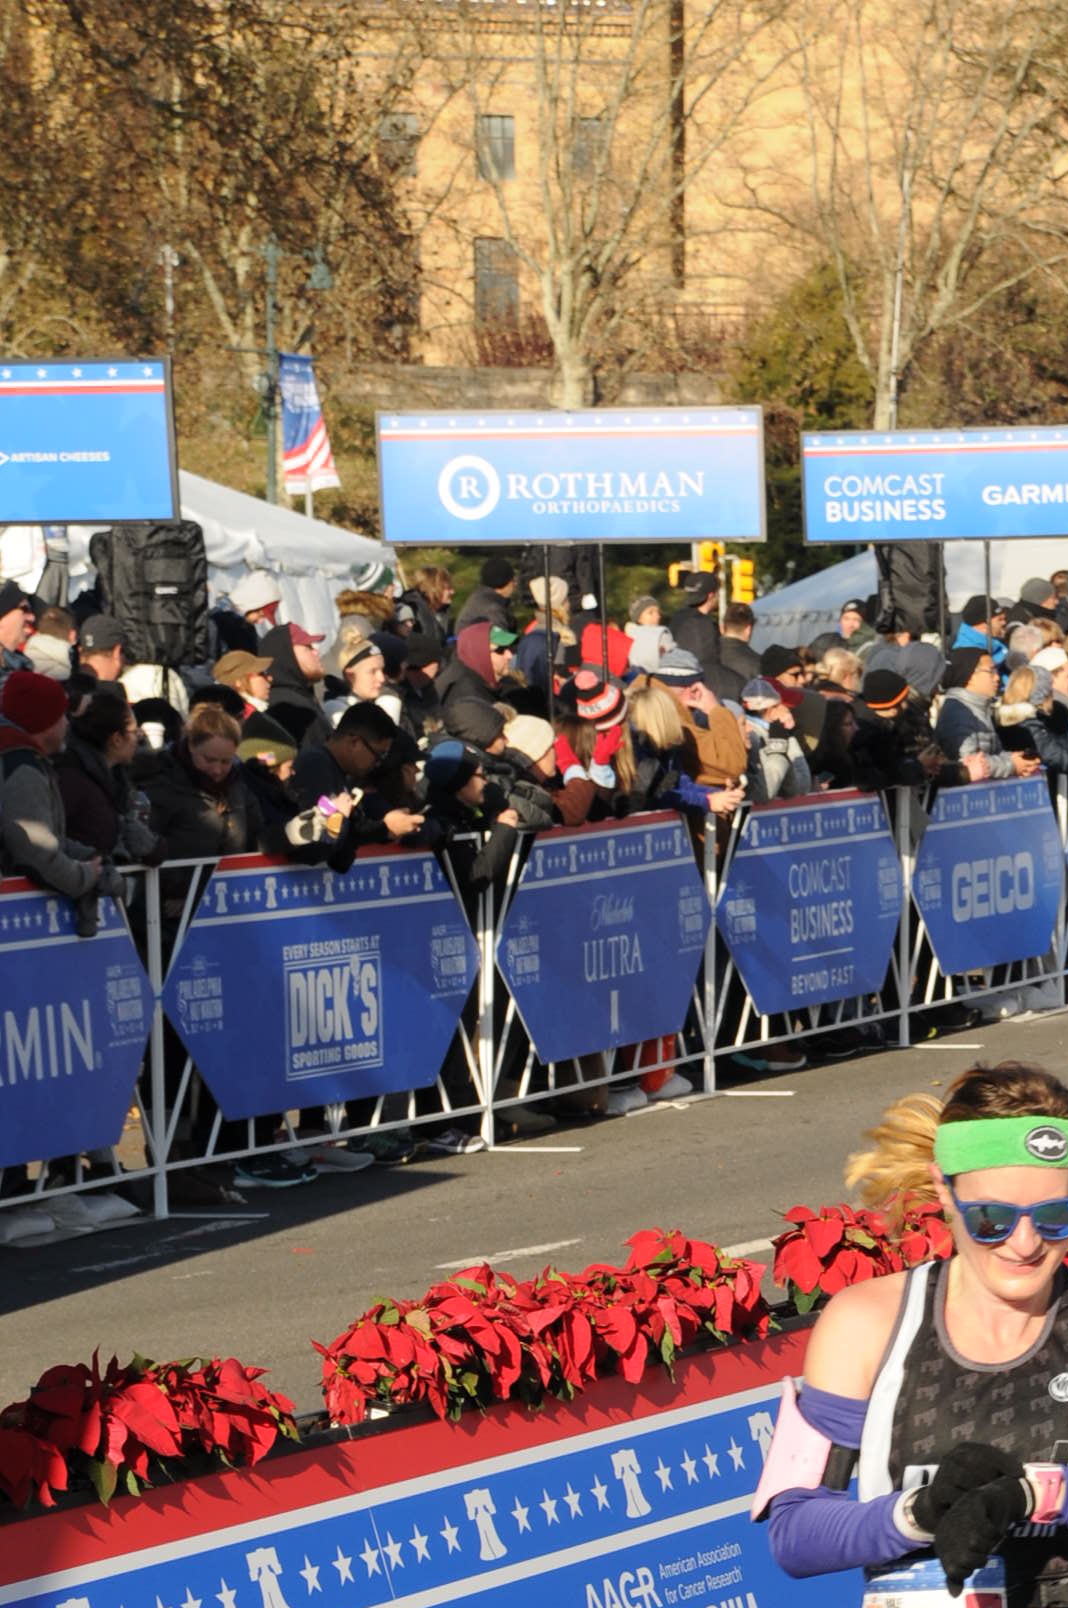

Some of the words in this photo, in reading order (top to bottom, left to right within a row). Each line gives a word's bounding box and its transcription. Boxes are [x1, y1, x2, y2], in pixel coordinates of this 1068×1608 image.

[458, 475, 482, 498] R
[507, 471, 705, 499] ROTHMAN
[824, 473, 946, 498] COMCAST
[532, 499, 681, 514] ORTHOPAEDICS
[825, 499, 947, 523] BUSINESS
[788, 855, 852, 899] COMCAST
[952, 852, 1034, 923] GEICO
[790, 900, 854, 944] BUSINESS
[283, 944, 308, 961] EVERY
[309, 940, 341, 958] SEASON
[342, 936, 370, 954] STARTS
[370, 935, 380, 950] AT
[584, 933, 644, 983] ULTRA
[792, 969, 828, 996] BEYOND
[831, 964, 855, 988] FAST
[290, 954, 378, 1048] DICK'S
[0, 999, 94, 1087] MIN
[292, 1047, 342, 1070] SPORTING
[344, 1041, 378, 1061] GOODS
[659, 1552, 697, 1580] American
[697, 1542, 742, 1568] Association
[665, 1588, 678, 1604] for
[678, 1581, 707, 1601] Cancer
[706, 1568, 742, 1593] Research
